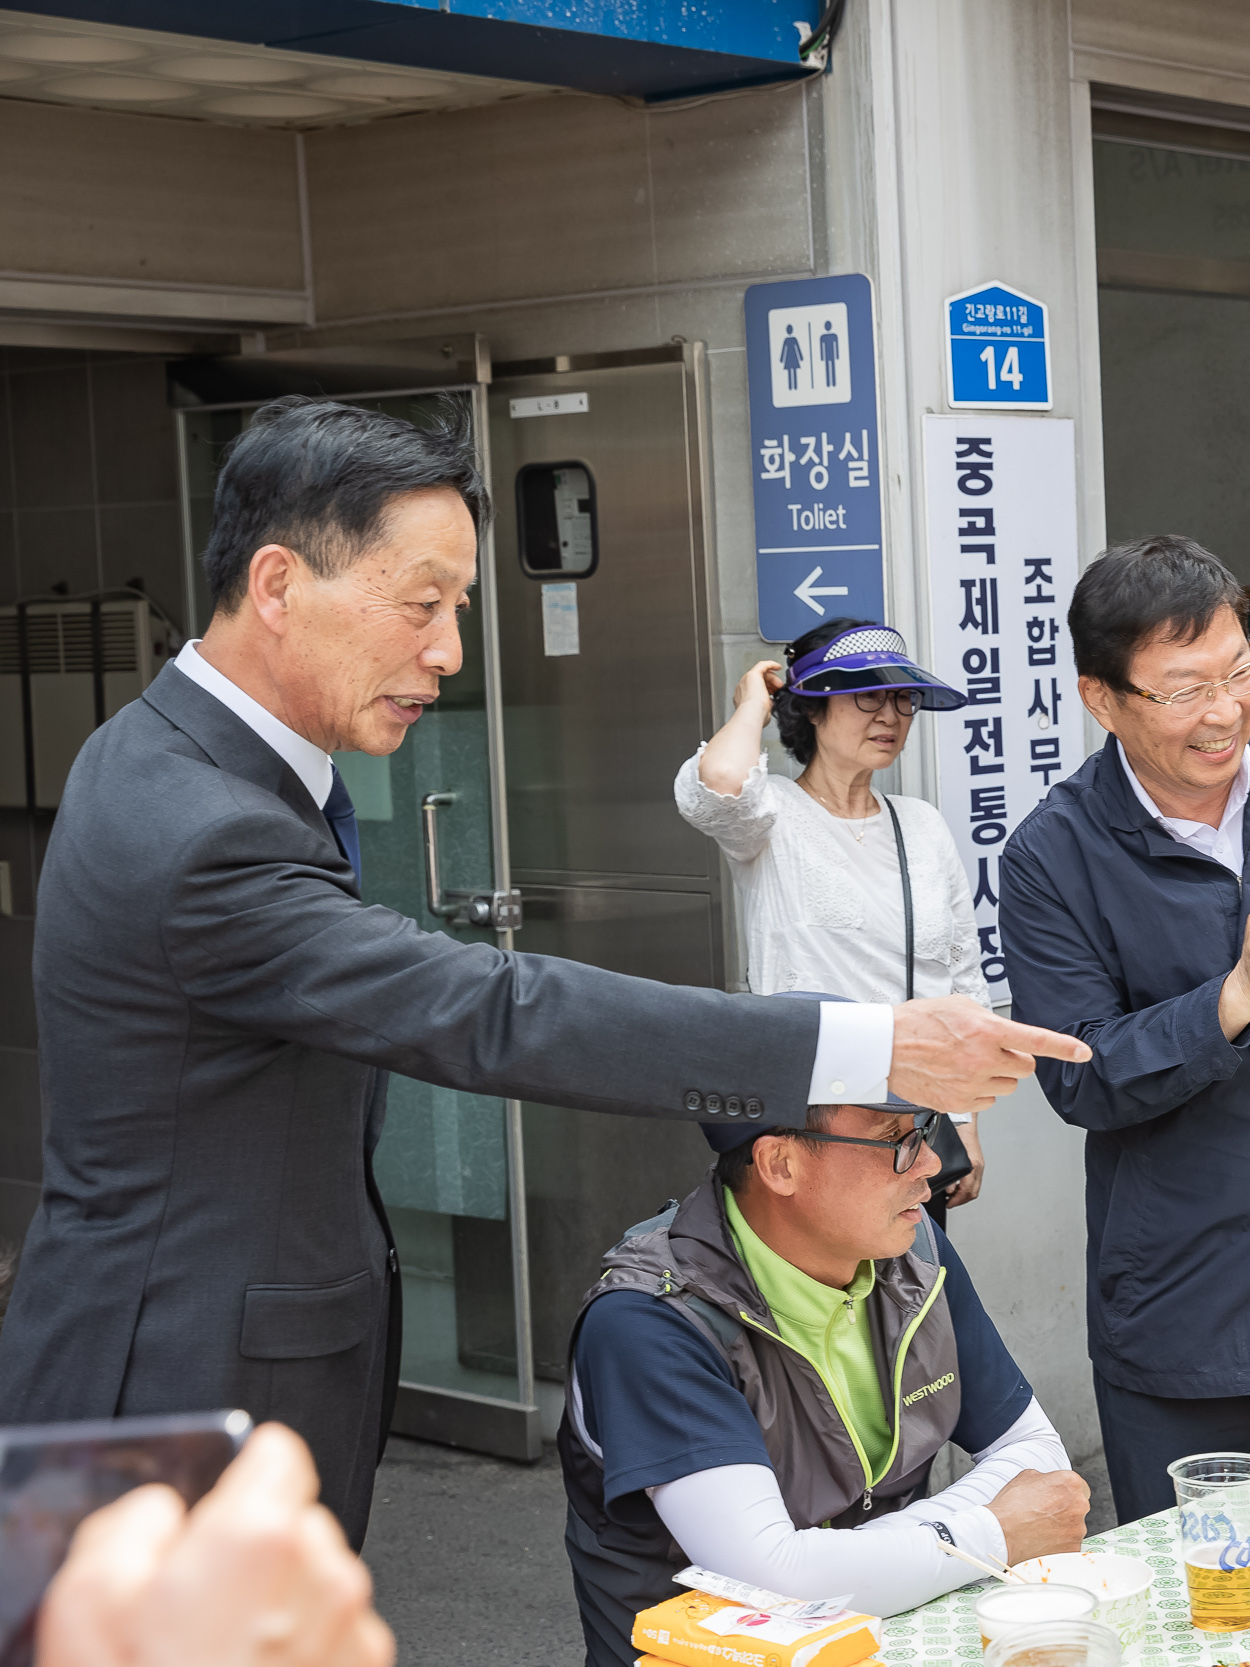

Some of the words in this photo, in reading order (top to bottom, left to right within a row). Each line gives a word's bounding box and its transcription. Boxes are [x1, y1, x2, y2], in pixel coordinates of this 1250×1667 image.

[962, 322, 1012, 335] Gingorang-ro
[1012, 325, 1034, 337] 11-gil
[964, 303, 1028, 324] 긴고랑로11길
[979, 345, 1024, 390] 14
[760, 429, 871, 490] 화장실
[787, 502, 847, 531] Toliet
[1023, 557, 1063, 788] 조합사무
[902, 1372, 955, 1407] WESTWOOD
